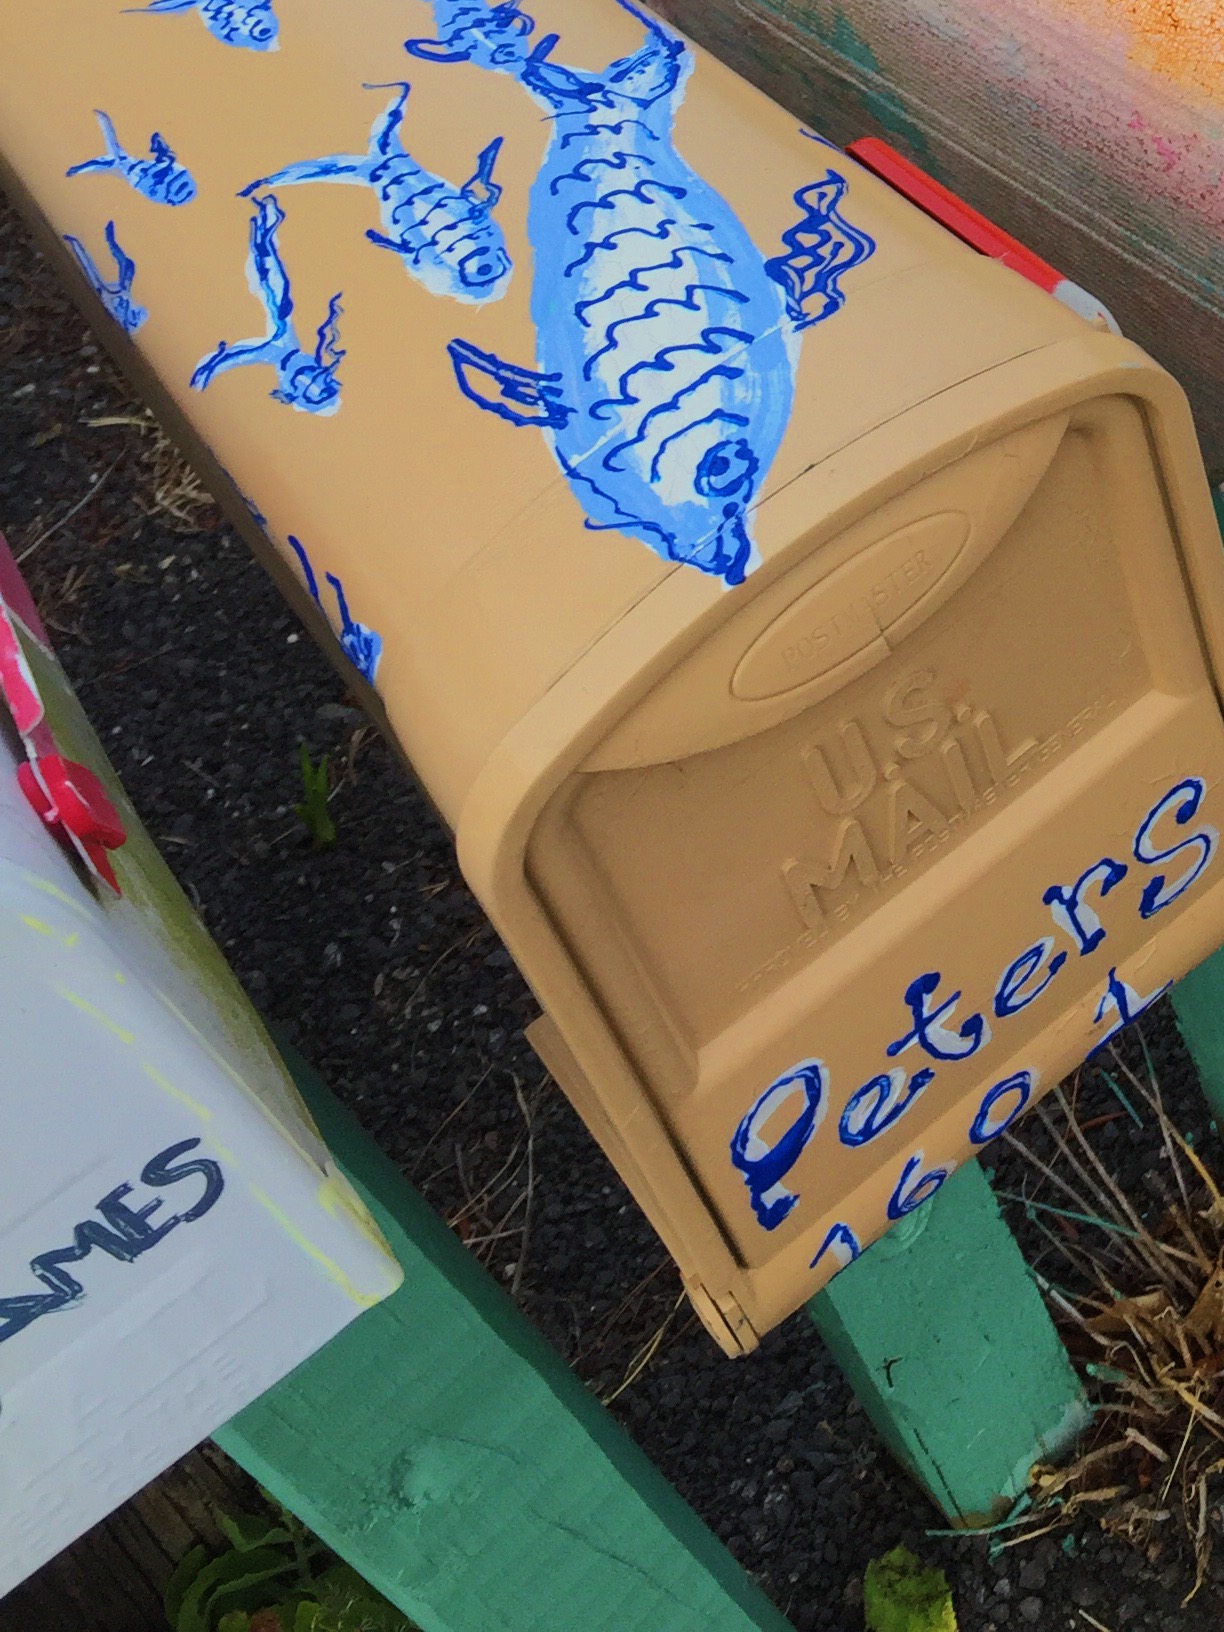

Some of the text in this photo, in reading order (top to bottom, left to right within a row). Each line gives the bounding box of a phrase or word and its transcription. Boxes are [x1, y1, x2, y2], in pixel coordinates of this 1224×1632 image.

[780, 549, 932, 668] POSTSTER
[781, 710, 1040, 935] MAIL
[730, 776, 1219, 1232] Peters
